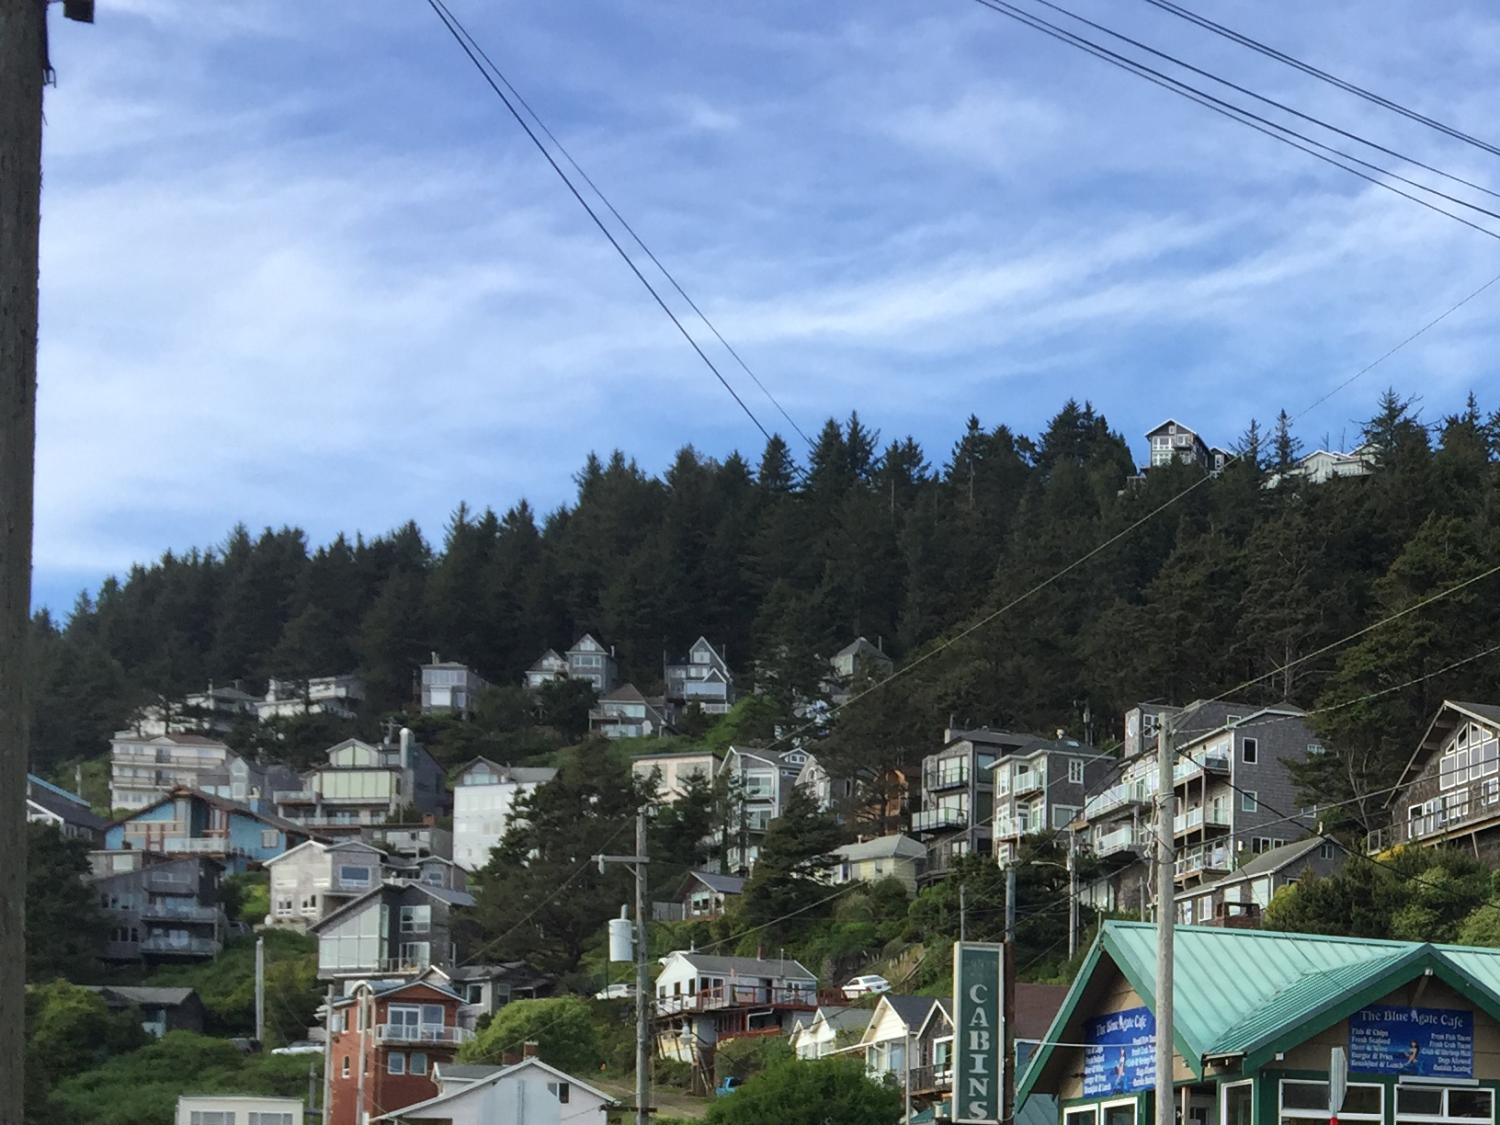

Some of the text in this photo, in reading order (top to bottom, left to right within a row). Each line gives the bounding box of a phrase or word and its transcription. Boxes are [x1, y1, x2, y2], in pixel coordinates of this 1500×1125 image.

[968, 983, 990, 1120] CABINS
[1361, 1010, 1381, 1021] The
[1384, 1010, 1409, 1022] Blue
[1410, 1009, 1438, 1026] Agate
